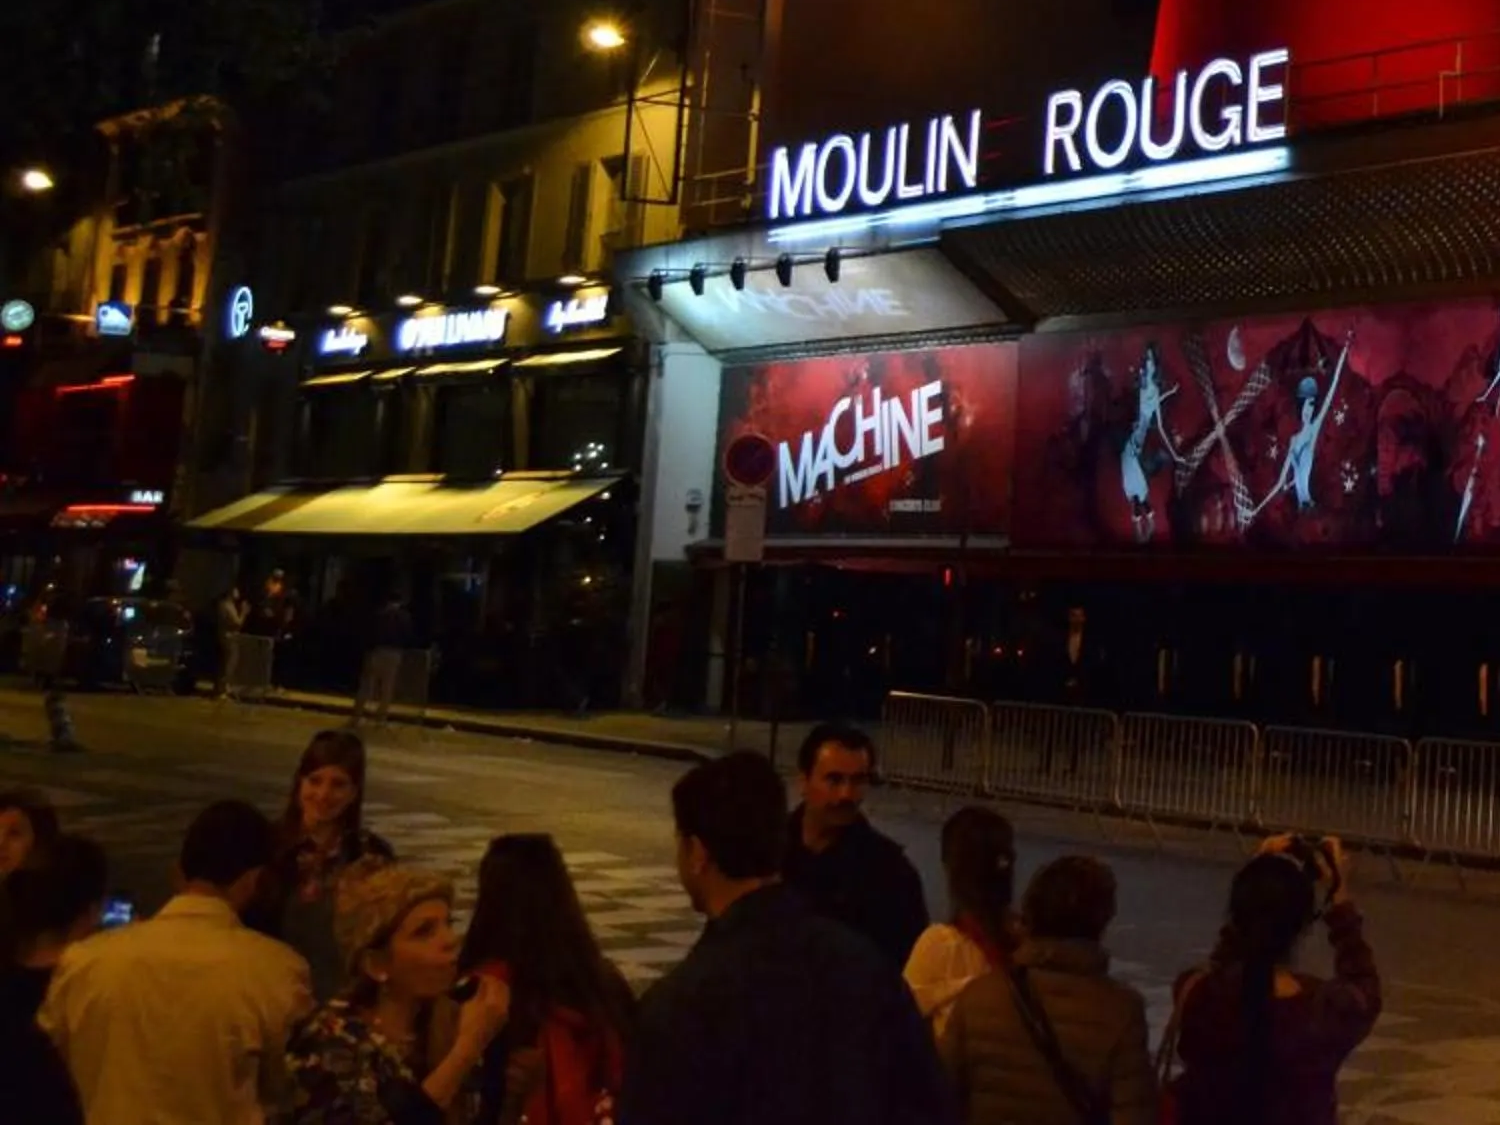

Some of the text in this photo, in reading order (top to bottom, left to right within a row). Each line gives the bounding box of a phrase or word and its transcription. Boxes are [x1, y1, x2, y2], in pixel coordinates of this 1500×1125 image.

[768, 48, 1289, 219] MOULIN ROUGE
[779, 379, 945, 509] MACHINE
